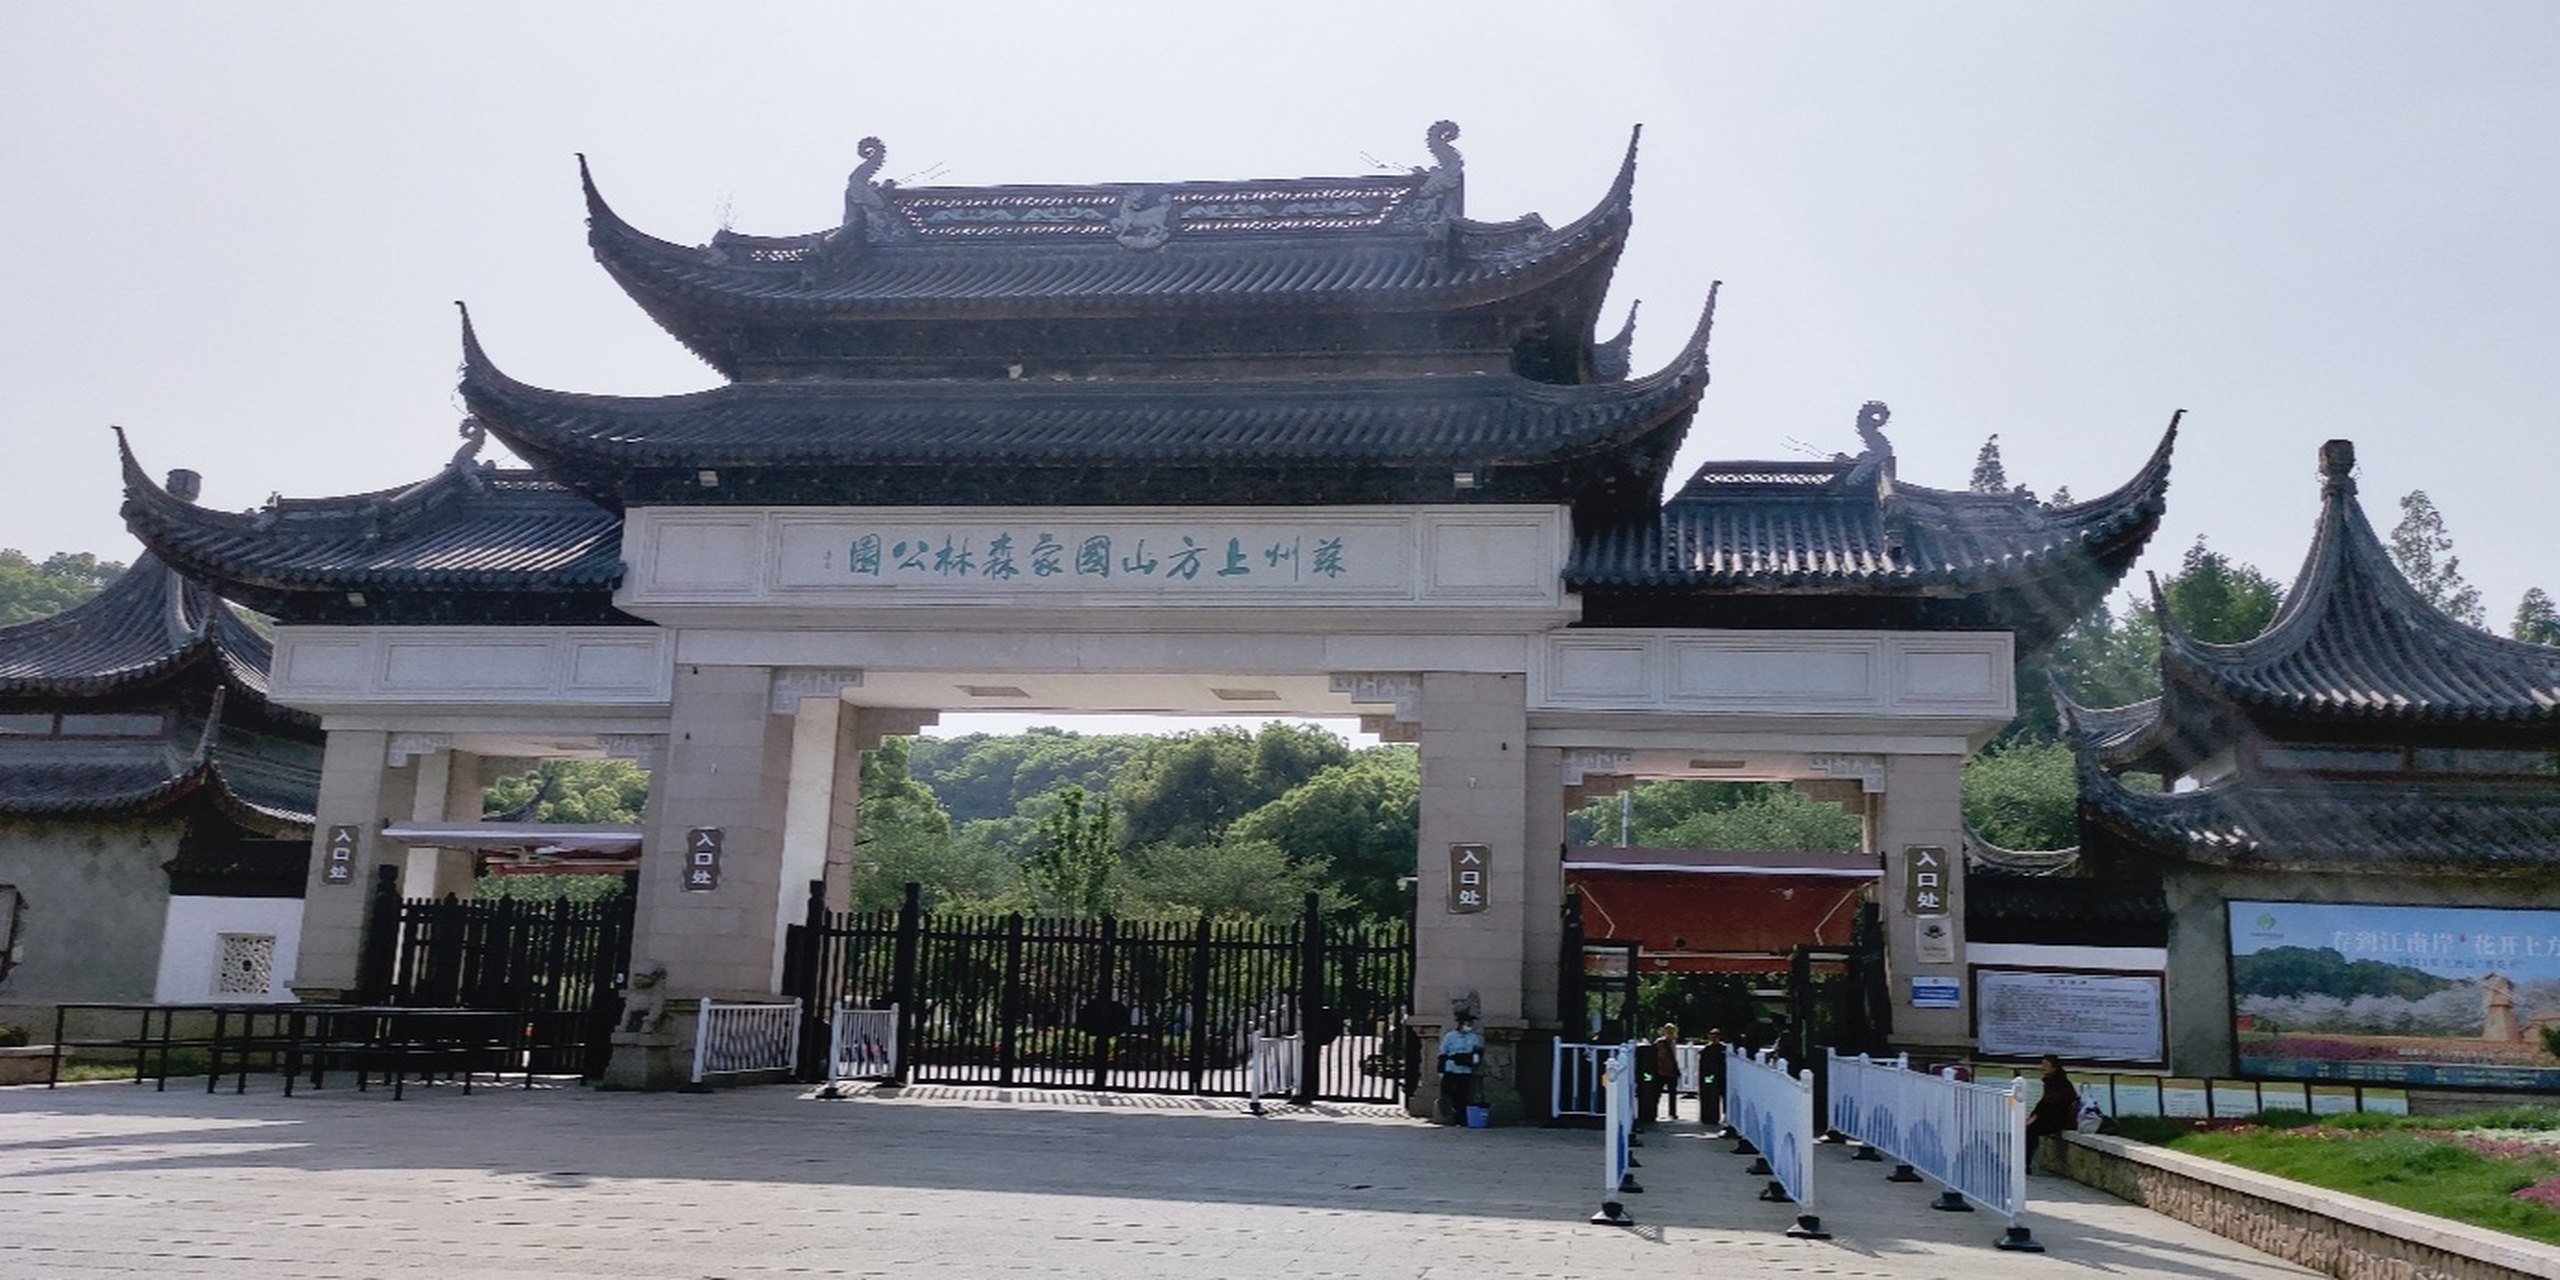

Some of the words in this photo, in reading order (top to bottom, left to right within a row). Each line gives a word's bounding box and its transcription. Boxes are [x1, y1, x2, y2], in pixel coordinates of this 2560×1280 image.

[329, 830, 351, 879] 入口处
[692, 832, 716, 884] 入口处
[1459, 850, 1480, 905] 入口处
[1916, 851, 1940, 907] 入口处
